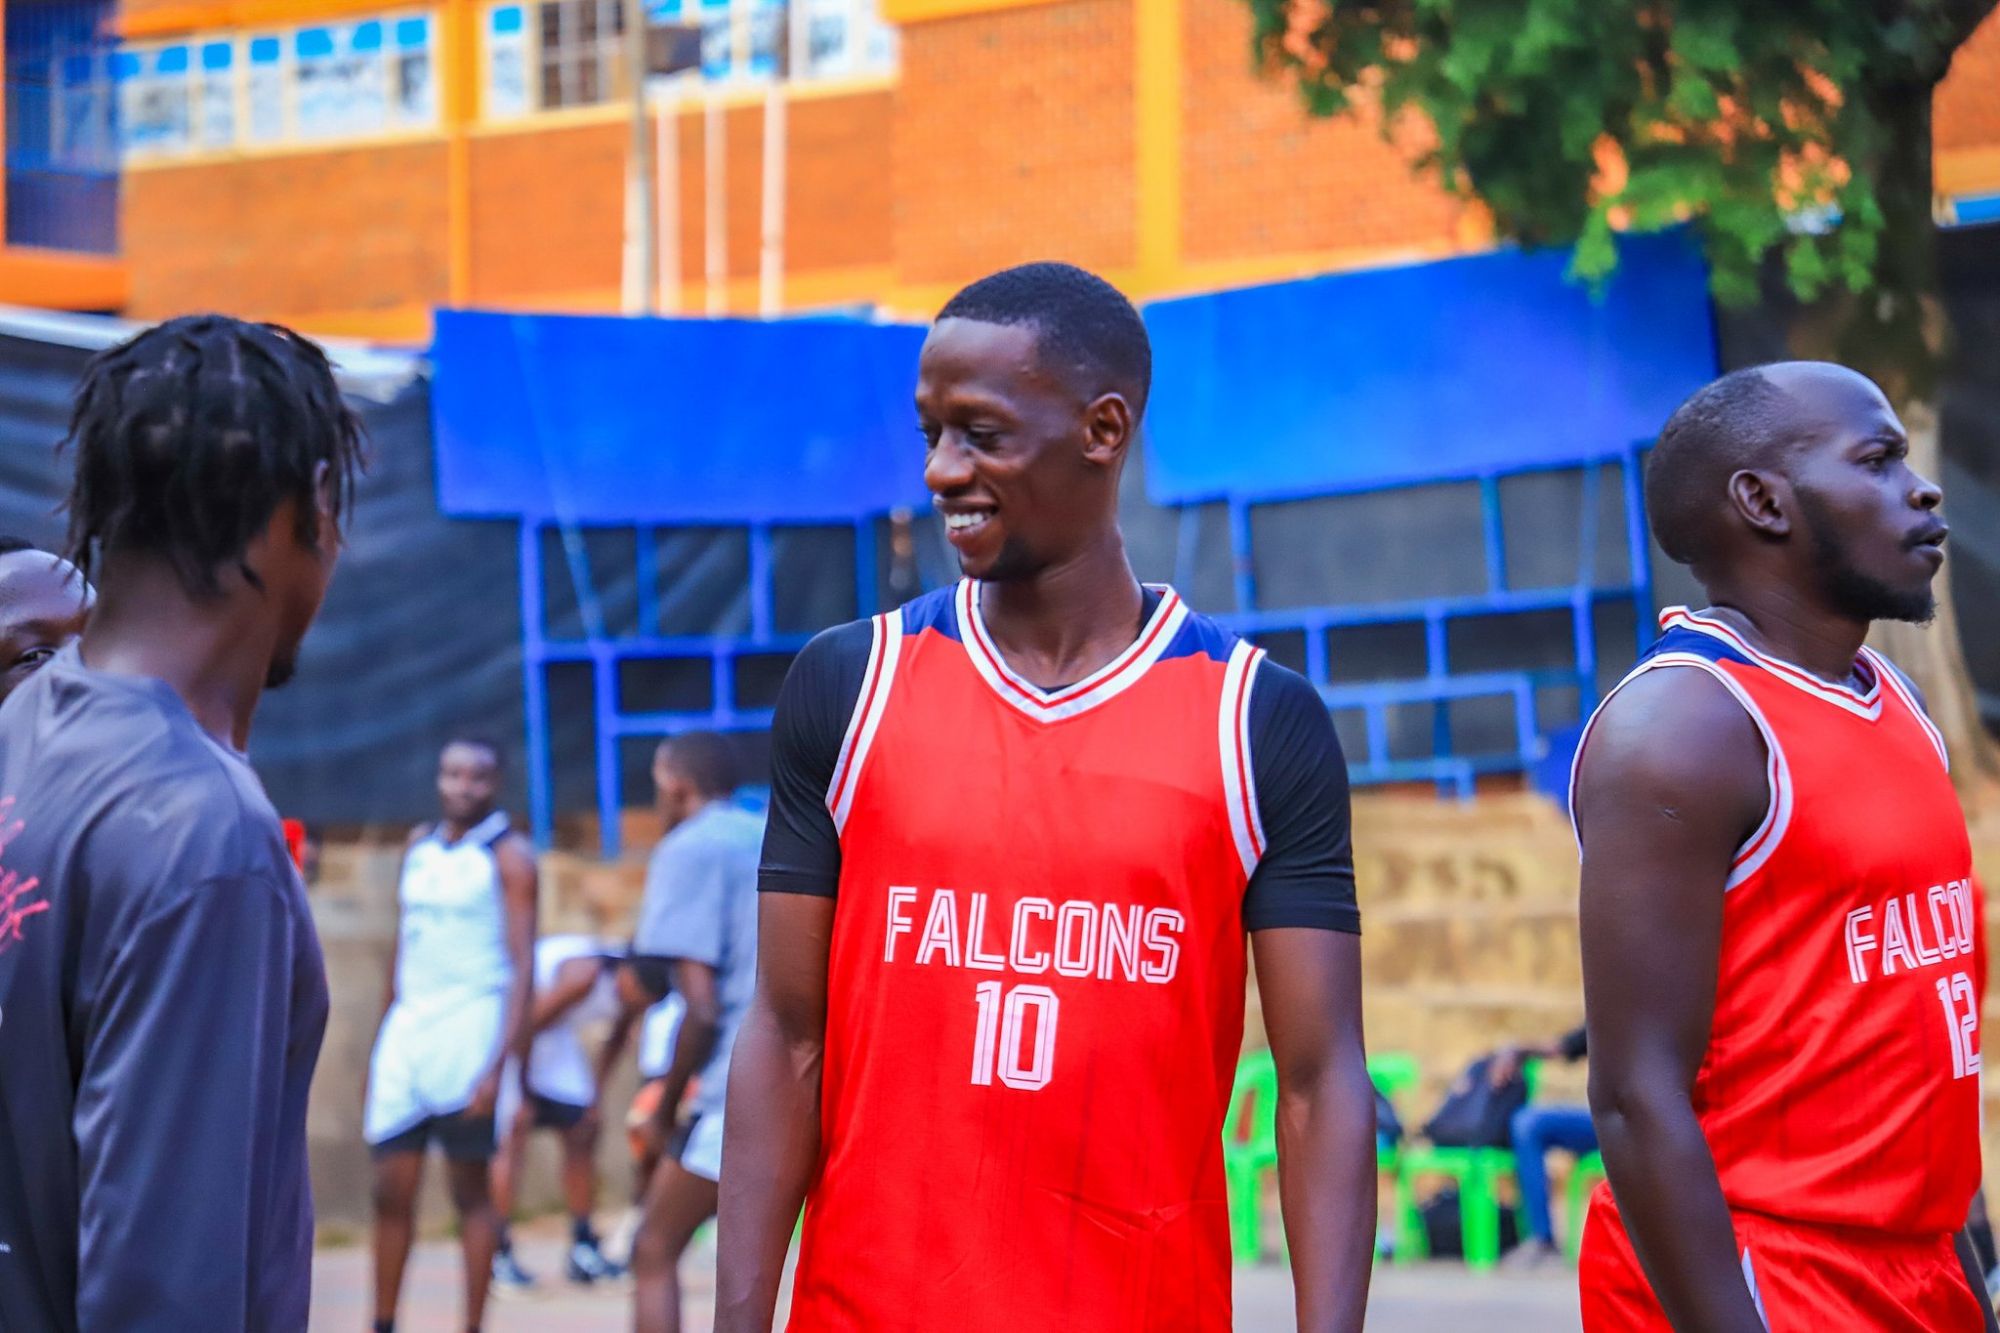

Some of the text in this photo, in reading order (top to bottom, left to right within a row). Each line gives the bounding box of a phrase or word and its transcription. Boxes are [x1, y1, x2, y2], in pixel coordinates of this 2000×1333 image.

[884, 886, 1185, 984] FALCONS
[971, 980, 1060, 1091] 10
[1936, 972, 1980, 1079] 12
